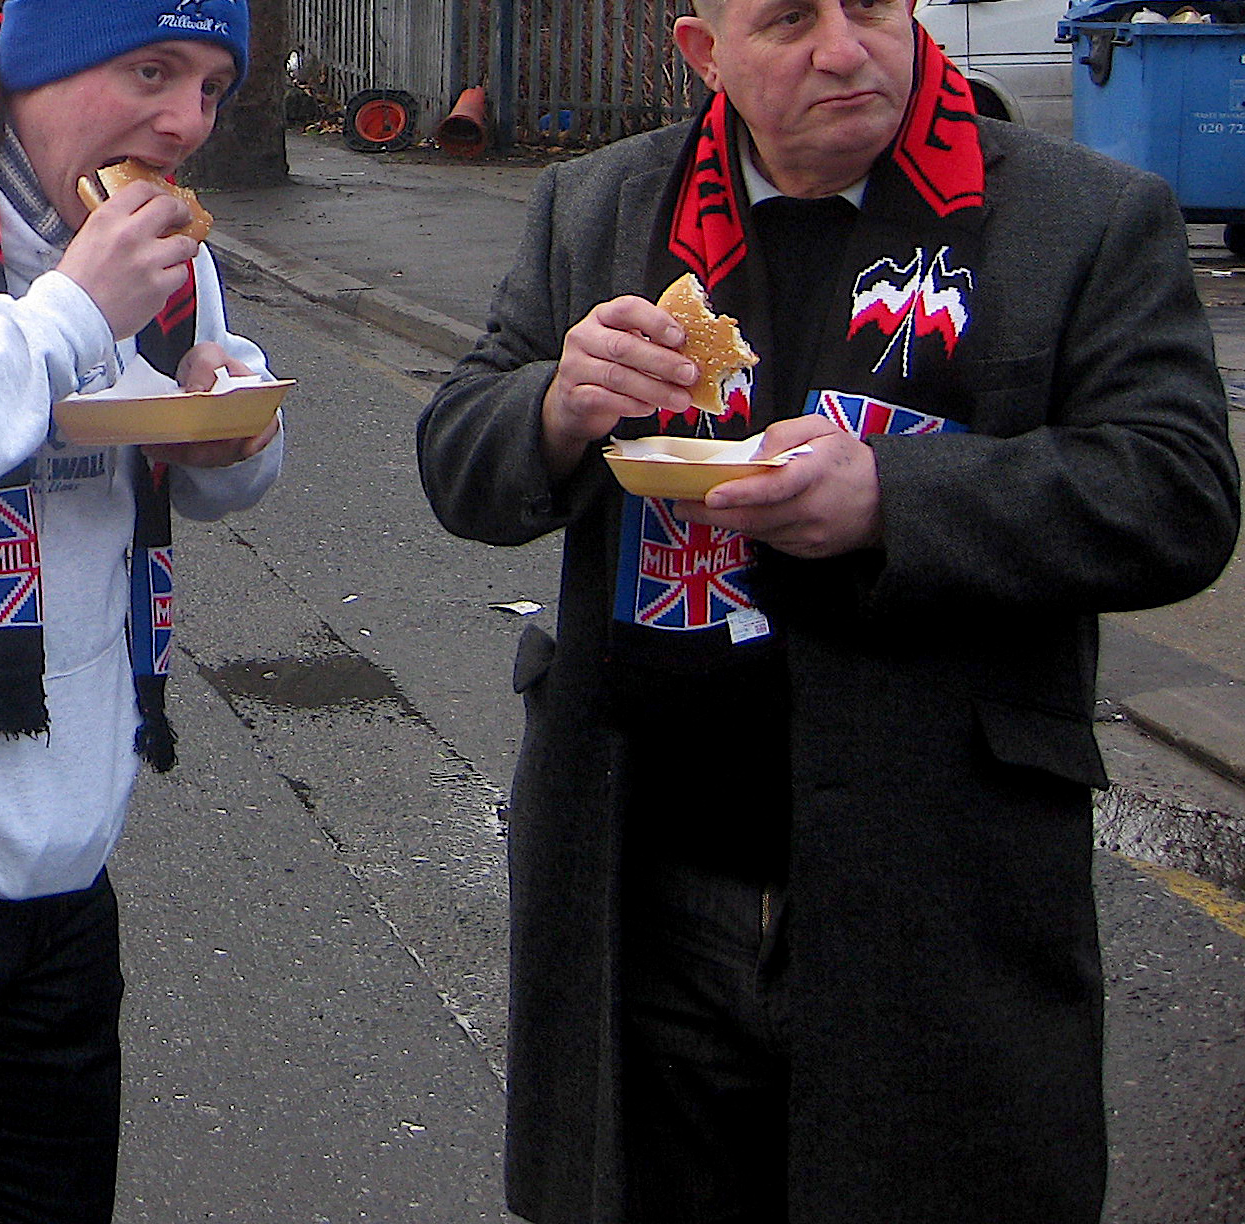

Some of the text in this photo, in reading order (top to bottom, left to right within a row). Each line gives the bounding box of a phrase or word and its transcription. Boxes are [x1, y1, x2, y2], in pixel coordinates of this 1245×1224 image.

[157, 14, 214, 32] Millwall
[1198, 122, 1224, 134] 020
[642, 535, 749, 577] MILLWALL
